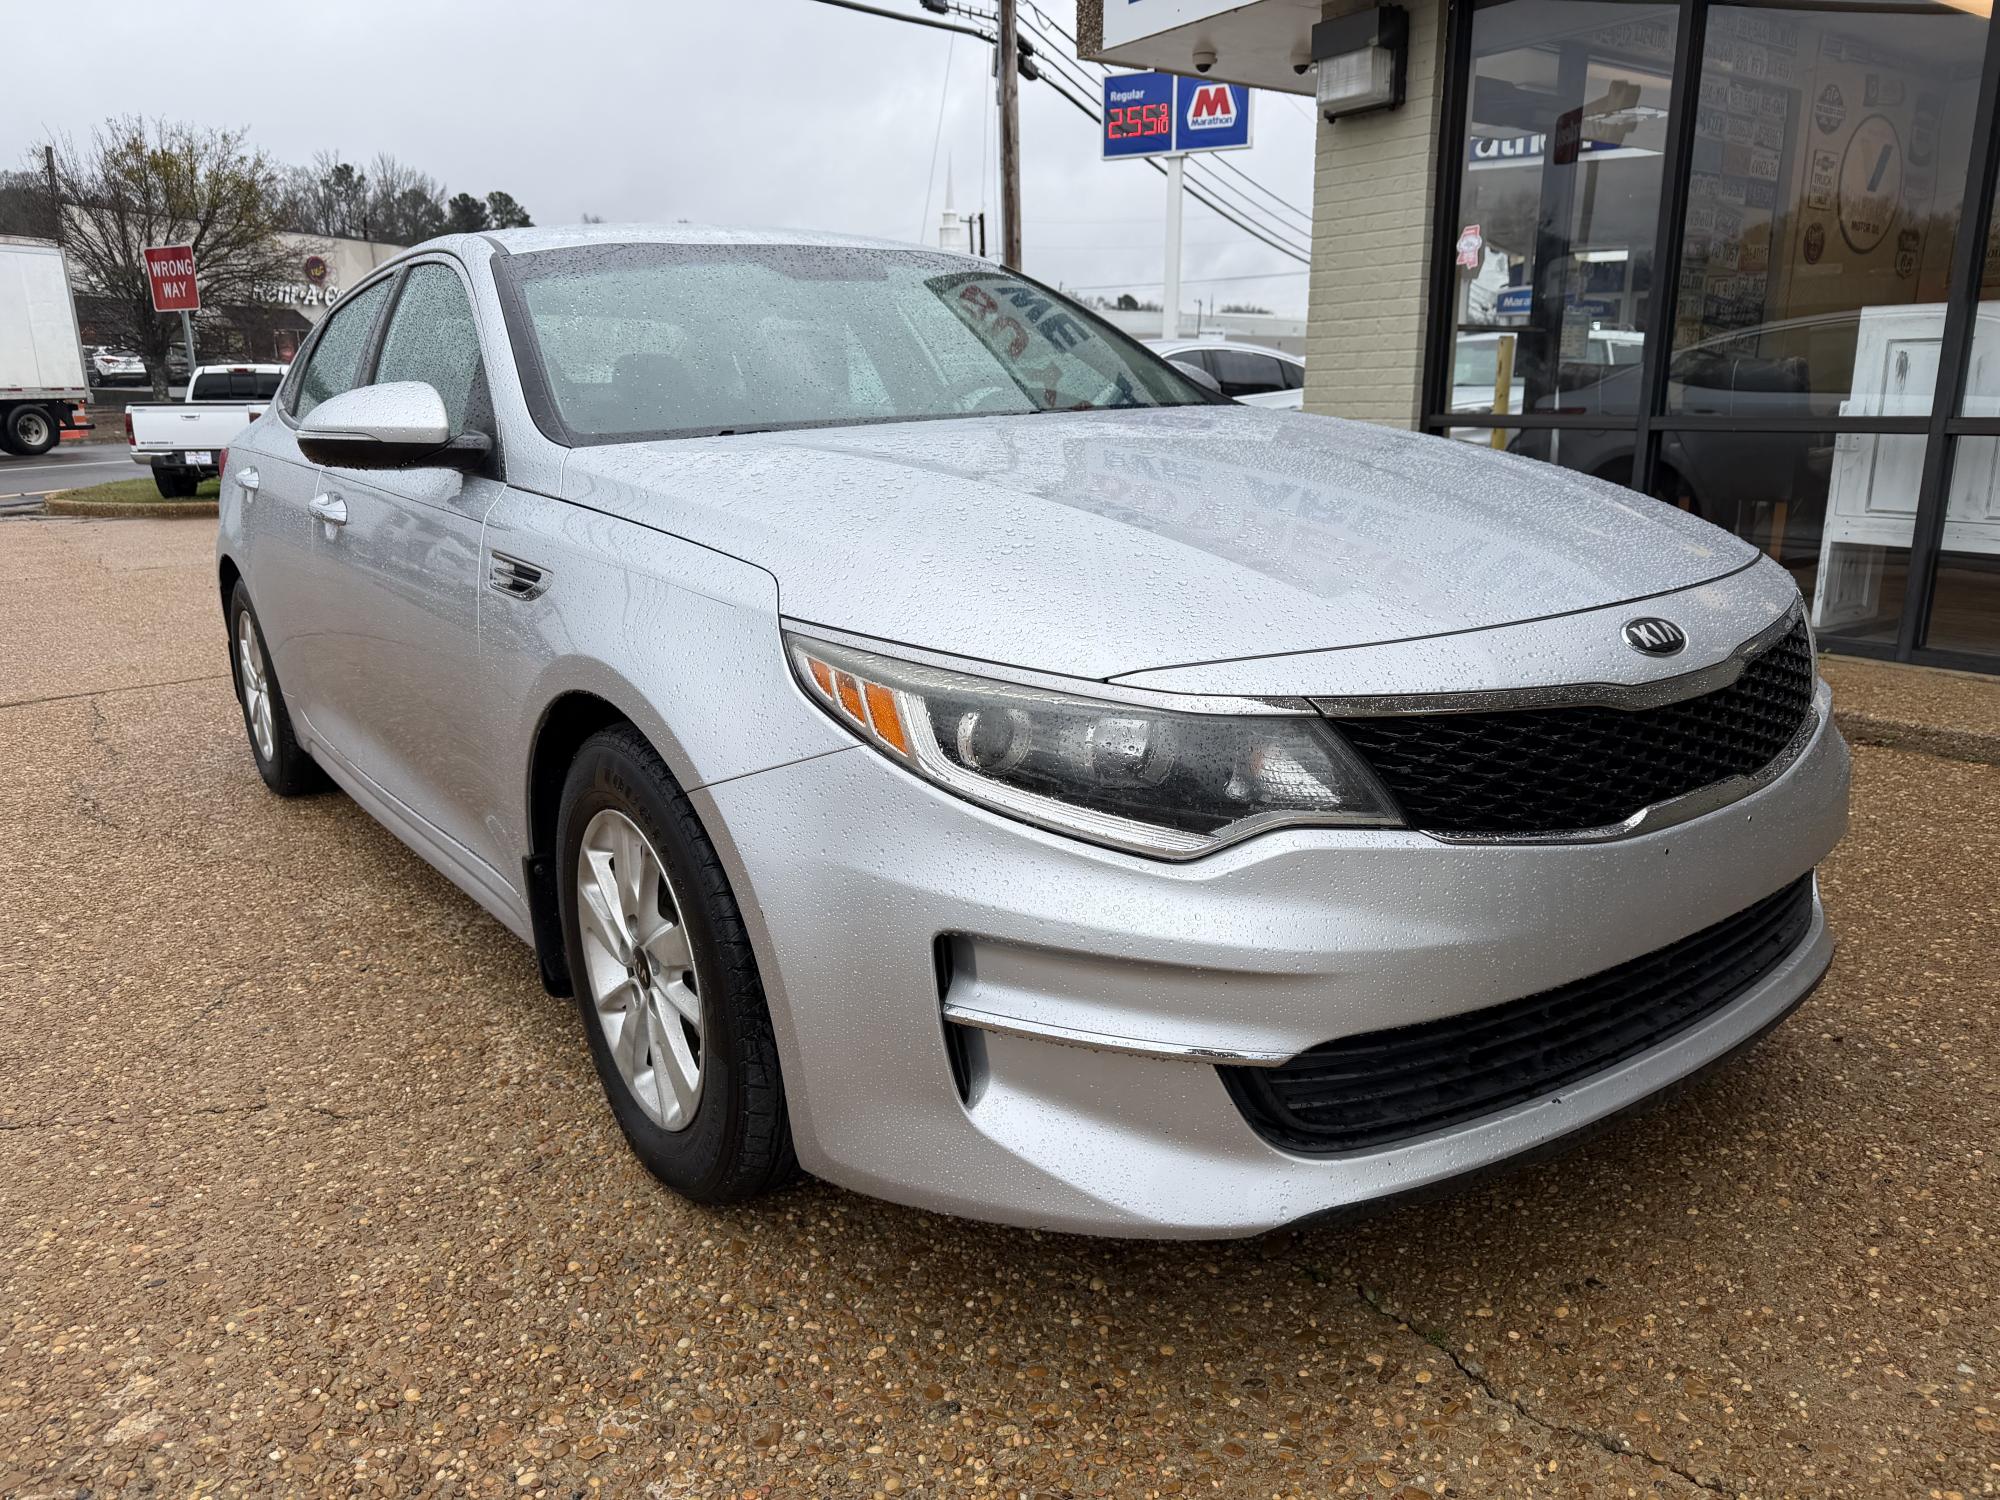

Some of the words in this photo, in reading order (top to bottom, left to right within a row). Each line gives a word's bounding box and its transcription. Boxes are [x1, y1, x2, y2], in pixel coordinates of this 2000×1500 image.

[1110, 89, 1145, 102] Regular
[1108, 104, 1157, 139] 2.55
[1191, 116, 1233, 127] Marathon
[1814, 173, 1833, 186] TRUCK
[151, 259, 193, 277] WRONG
[162, 281, 188, 299] WAY
[1630, 621, 1682, 648] KIA
